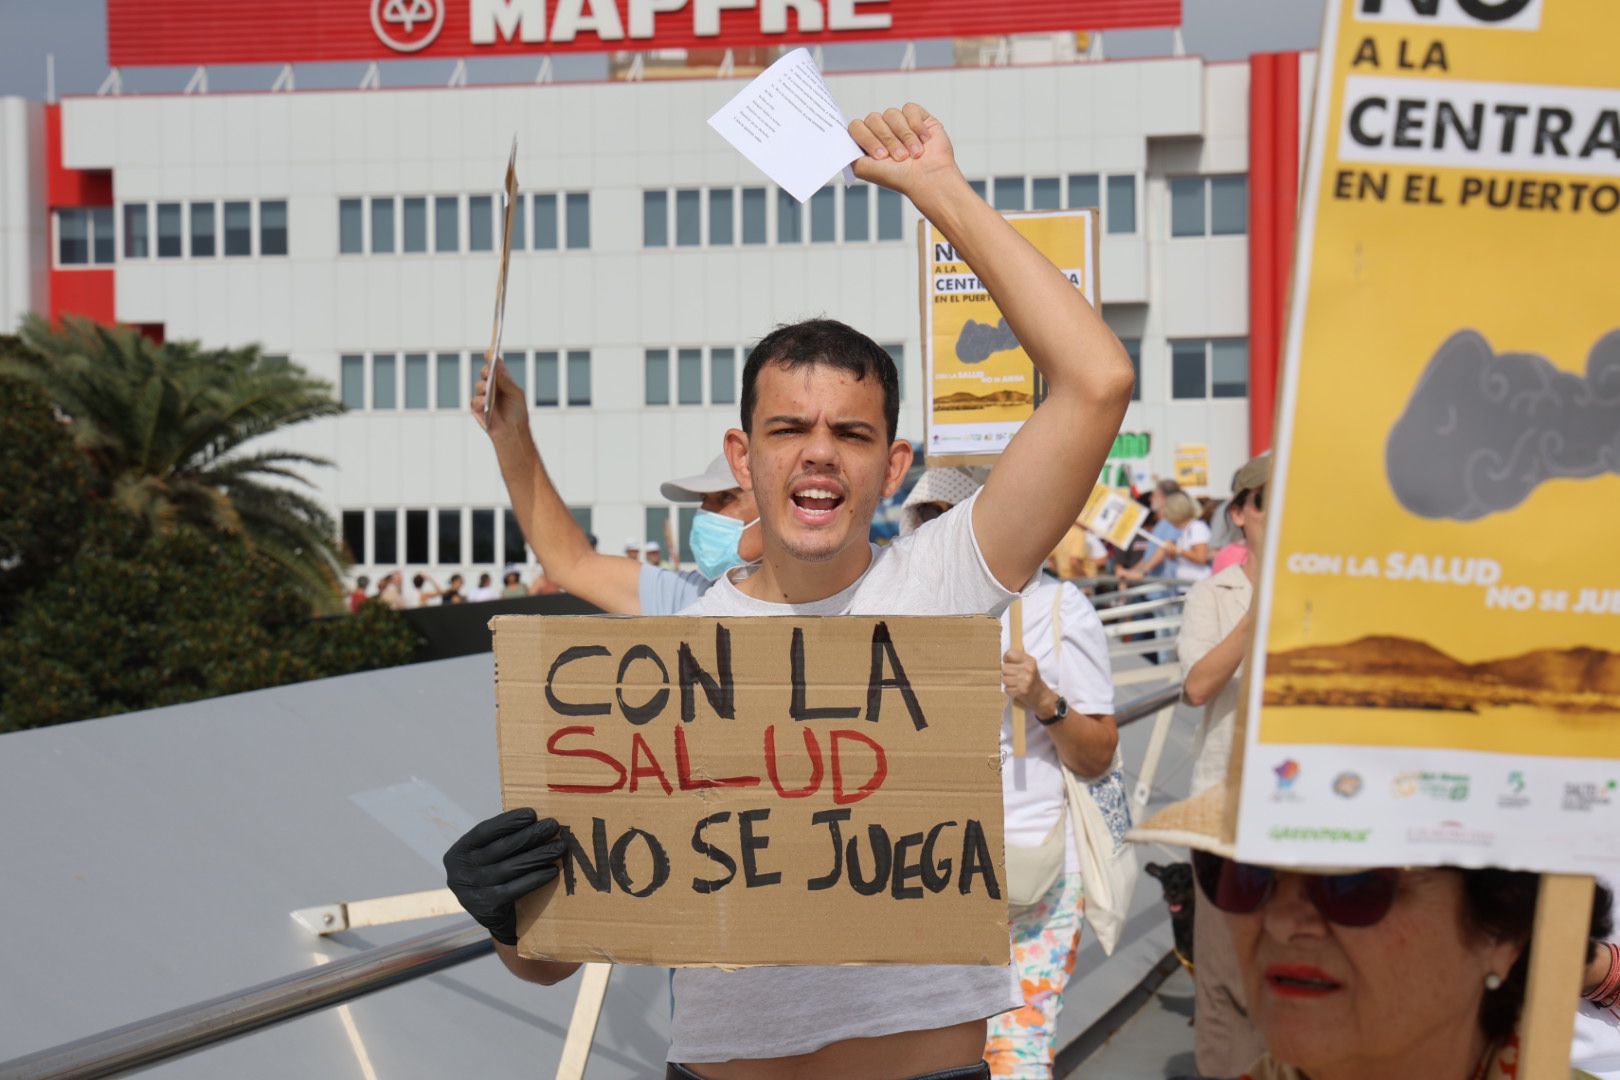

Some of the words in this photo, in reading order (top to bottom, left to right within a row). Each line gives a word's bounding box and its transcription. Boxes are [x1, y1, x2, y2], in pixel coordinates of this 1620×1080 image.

[1352, 37, 1380, 68] A
[1397, 40, 1448, 71] LA
[1334, 170, 1389, 201] EN
[1403, 175, 1444, 206] EL
[1460, 177, 1620, 214] PUERTO
[935, 243, 965, 261] N
[1287, 552, 1342, 575] CON
[1347, 554, 1379, 577] LA
[1385, 551, 1501, 586] SALUD
[1485, 584, 1535, 611] NO
[545, 622, 736, 725] CON
[790, 621, 928, 731] LA
[547, 724, 888, 805] SALUD
[559, 816, 671, 898] NO
[691, 808, 782, 894] SE
[808, 807, 1002, 900] JUEGA
